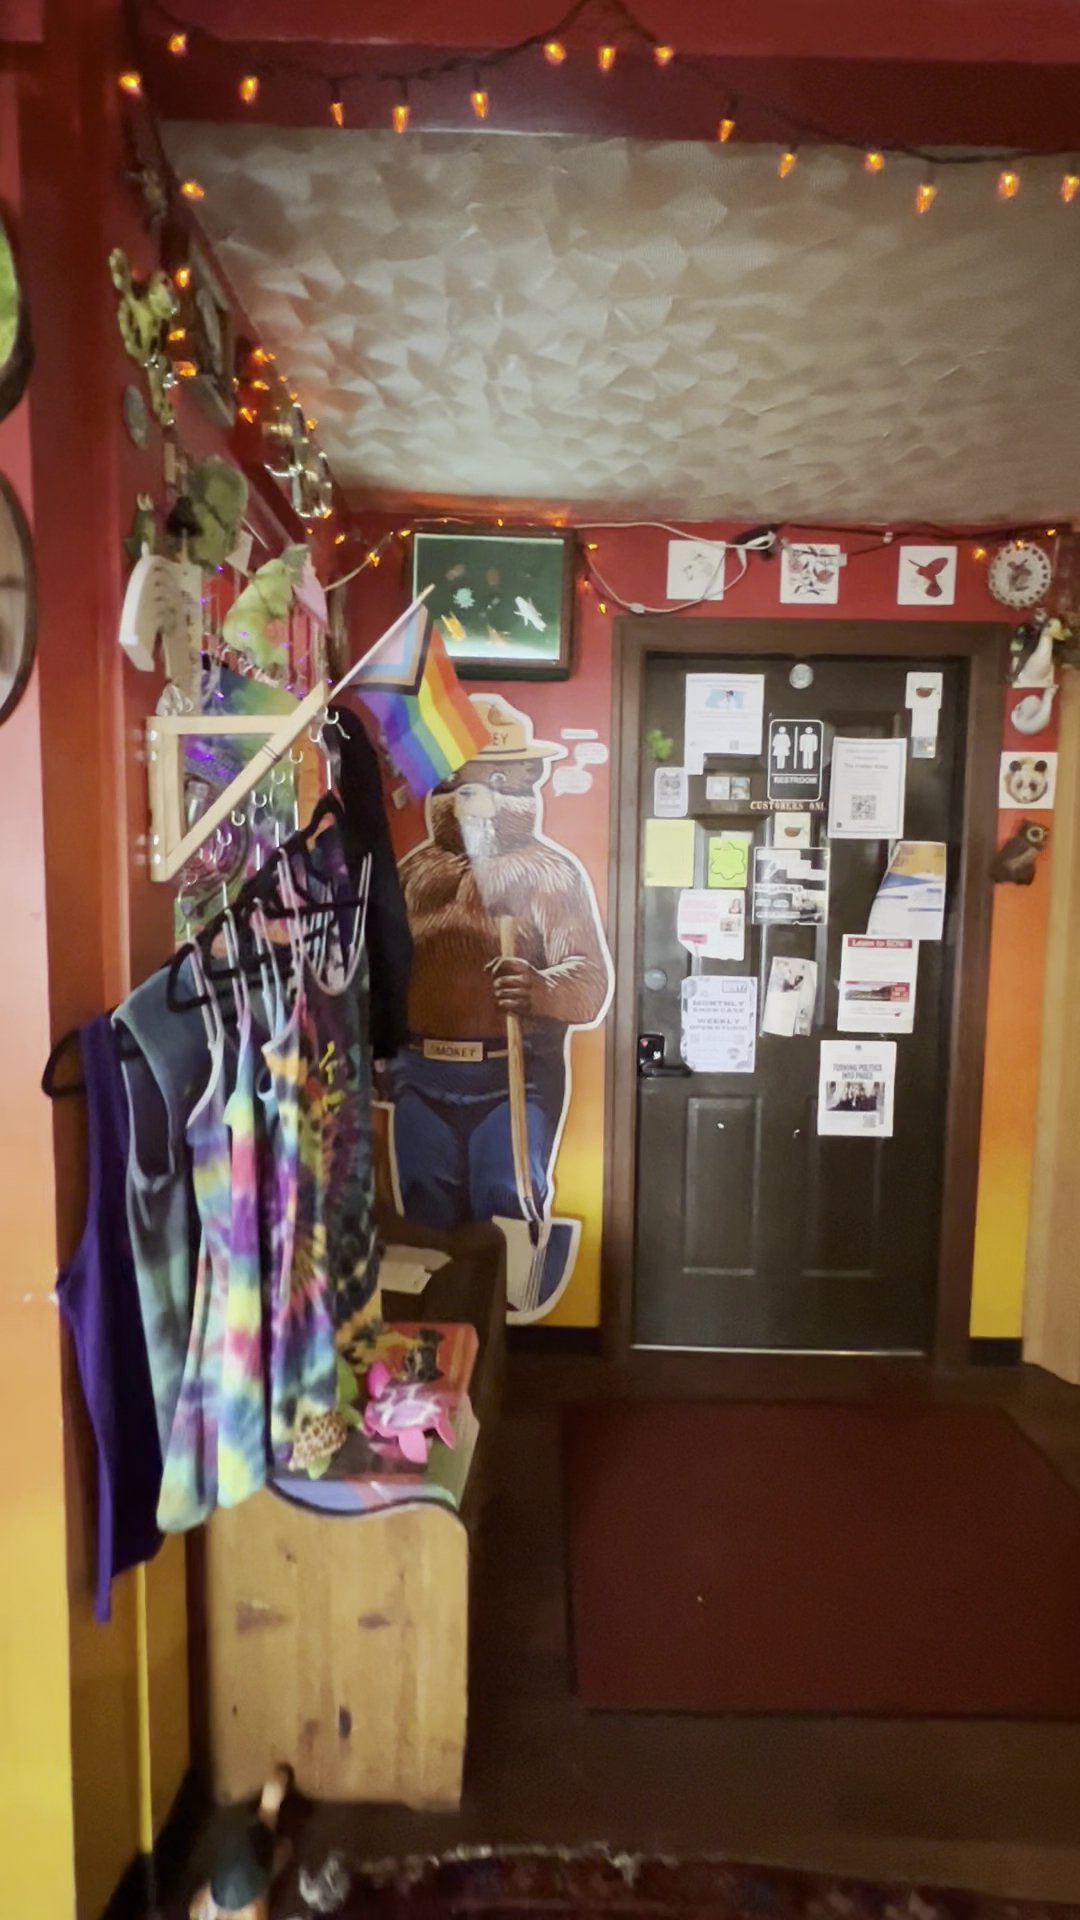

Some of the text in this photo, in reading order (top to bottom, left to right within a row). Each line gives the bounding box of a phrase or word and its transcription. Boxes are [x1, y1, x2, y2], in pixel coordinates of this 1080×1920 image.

[773, 776, 817, 784] RESTROOM
[809, 801, 826, 811] ONL
[858, 1064, 882, 1072] POLITICS
